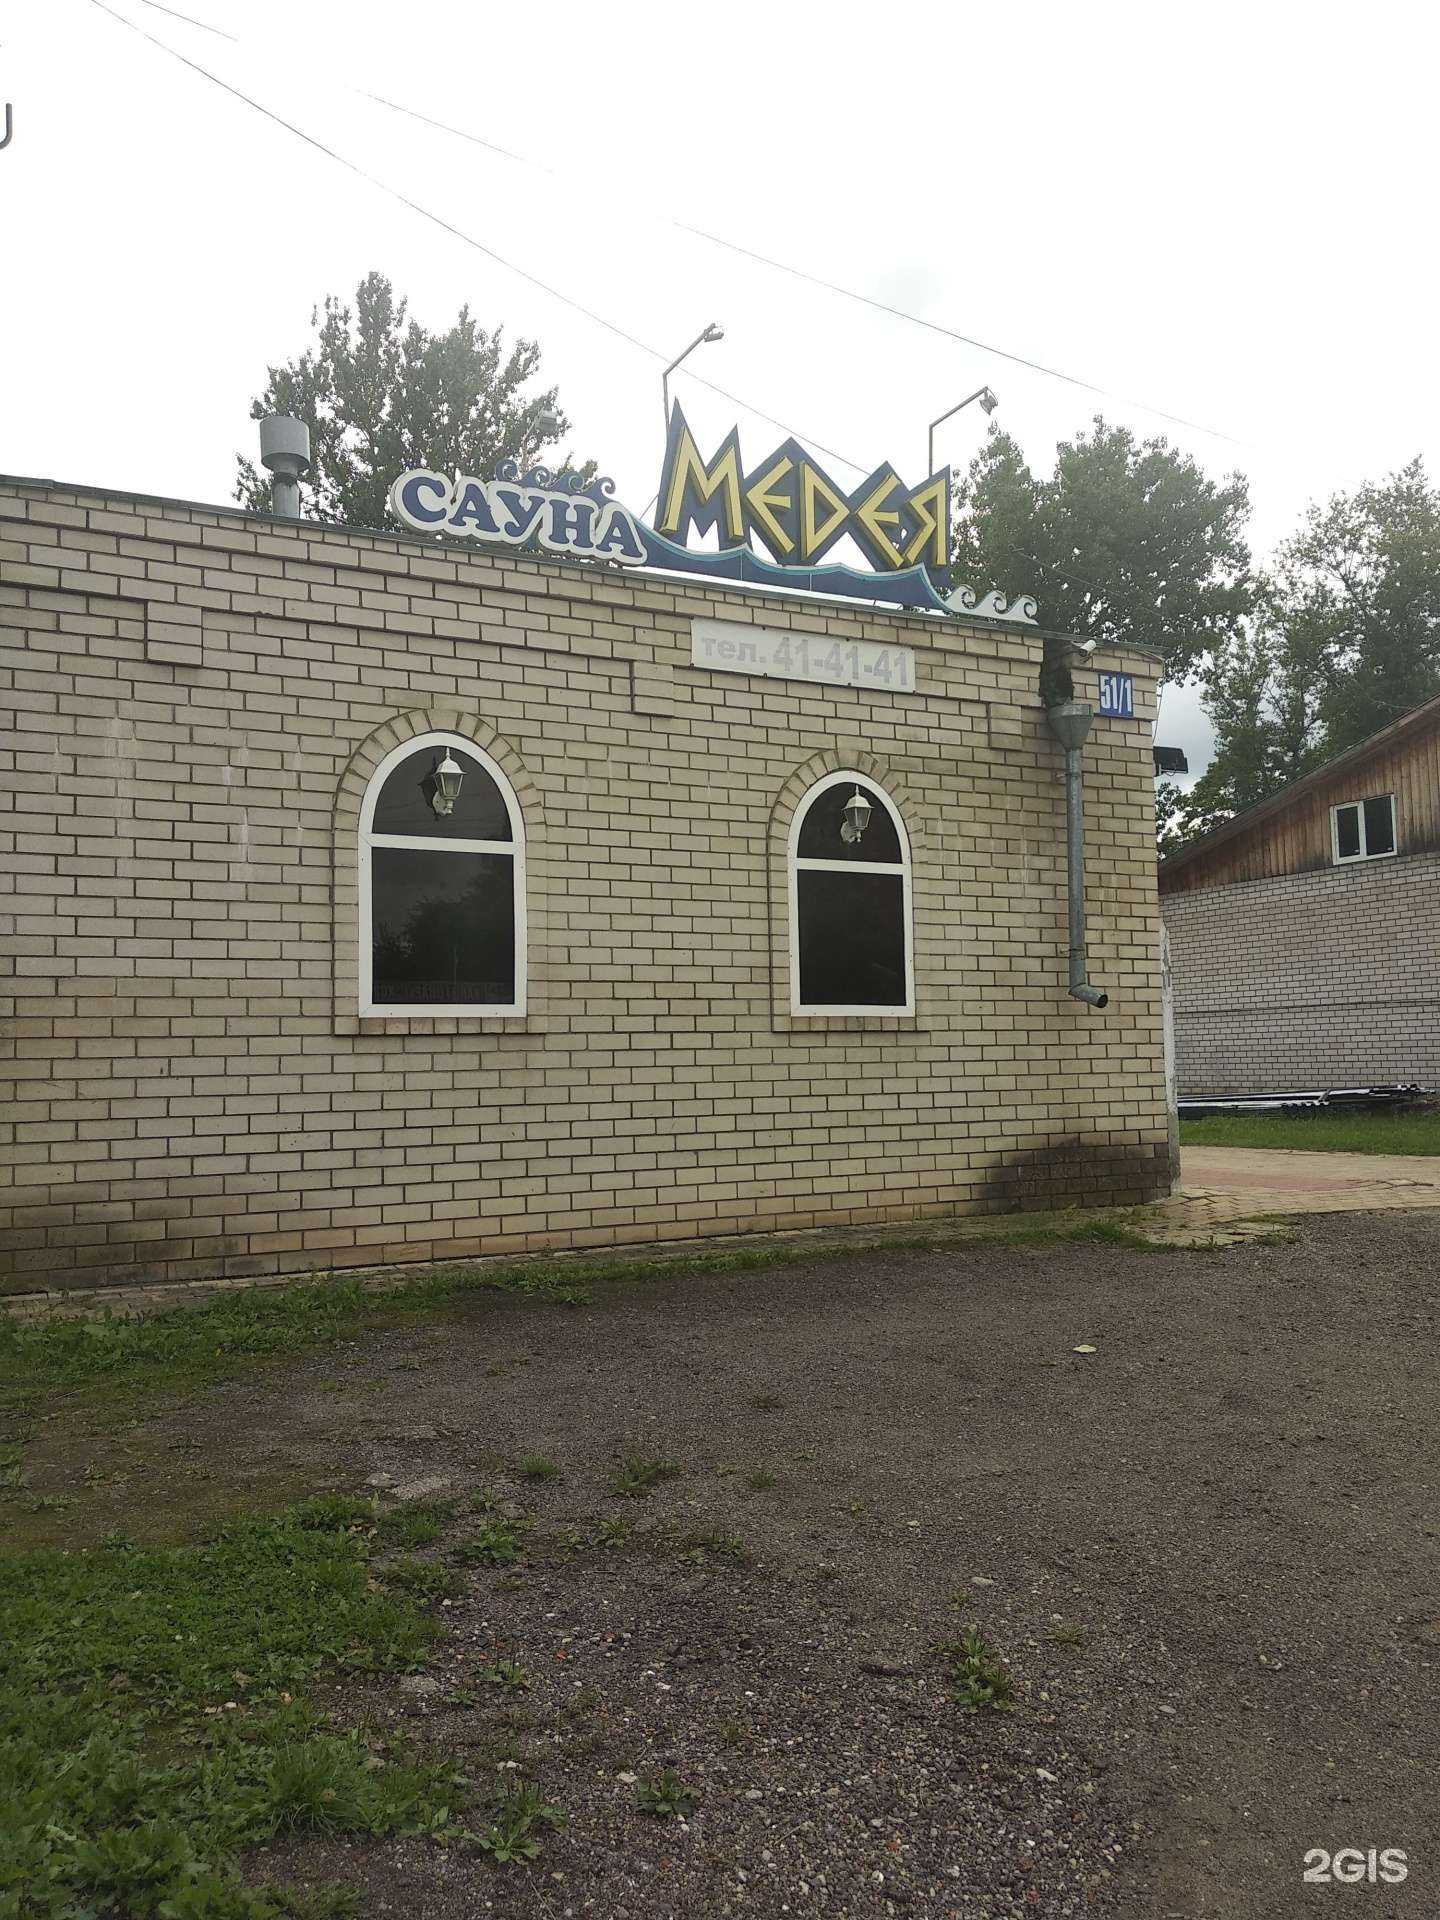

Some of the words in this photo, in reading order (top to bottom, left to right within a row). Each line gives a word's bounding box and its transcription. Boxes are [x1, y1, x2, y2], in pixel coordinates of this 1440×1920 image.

[401, 476, 642, 558] САУНА
[702, 636, 768, 663] тел.
[773, 635, 908, 687] 41-41-41
[1100, 675, 1132, 714] 51/1
